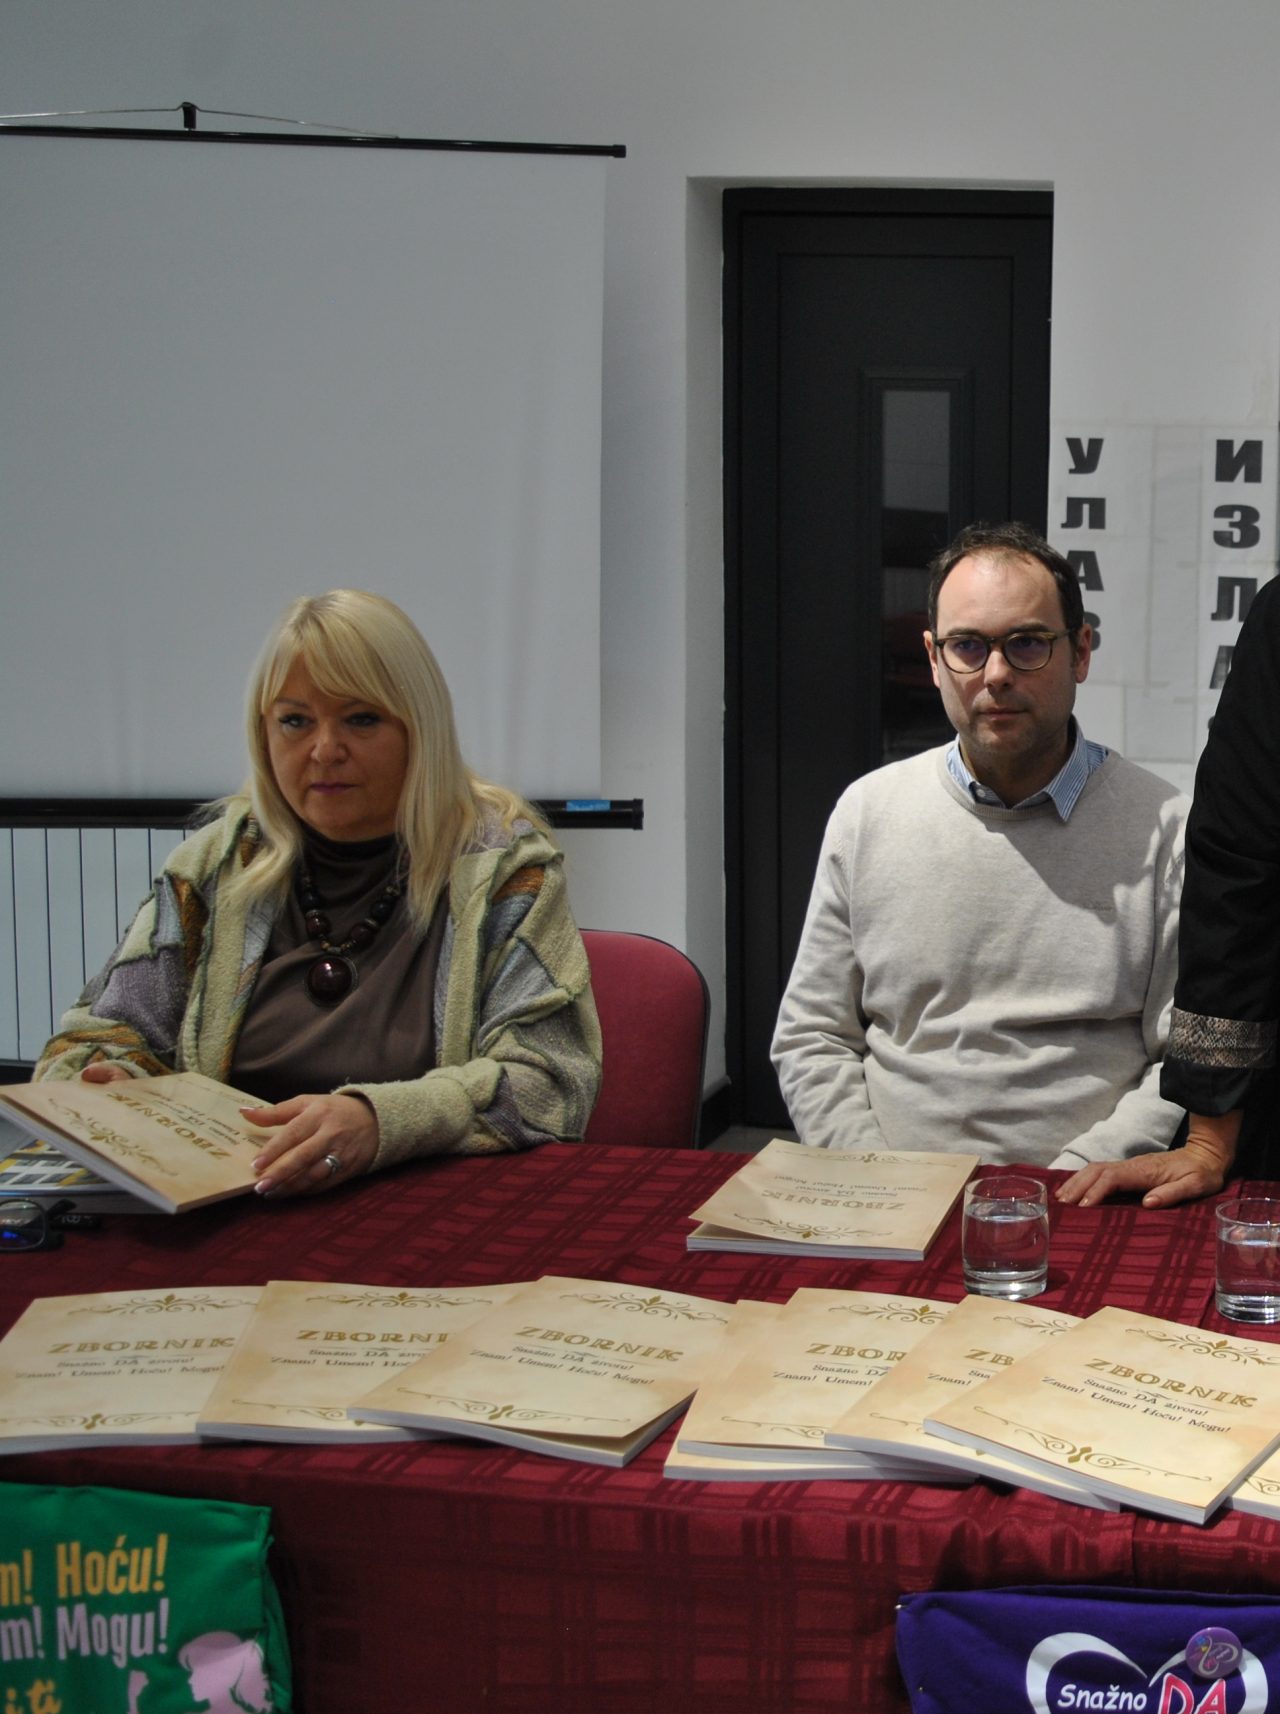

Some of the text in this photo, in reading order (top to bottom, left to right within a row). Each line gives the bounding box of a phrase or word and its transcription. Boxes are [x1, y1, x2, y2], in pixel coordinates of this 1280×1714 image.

[106, 1092, 232, 1160] ZBORNIK
[761, 1190, 906, 1210] ZBORNIK
[48, 1337, 235, 1354] ZBORNIK
[296, 1330, 451, 1343] ZBORNI
[514, 1326, 684, 1362] ZBORNIK
[805, 1343, 907, 1362] ZBOR
[1085, 1358, 1258, 1408] ZBORNIK
[1133, 1393, 1158, 1405] DA
[57, 1533, 168, 1598] Hoću!
[57, 1597, 169, 1669] Mogu!
[1057, 1672, 1227, 1714] Snažno DA
